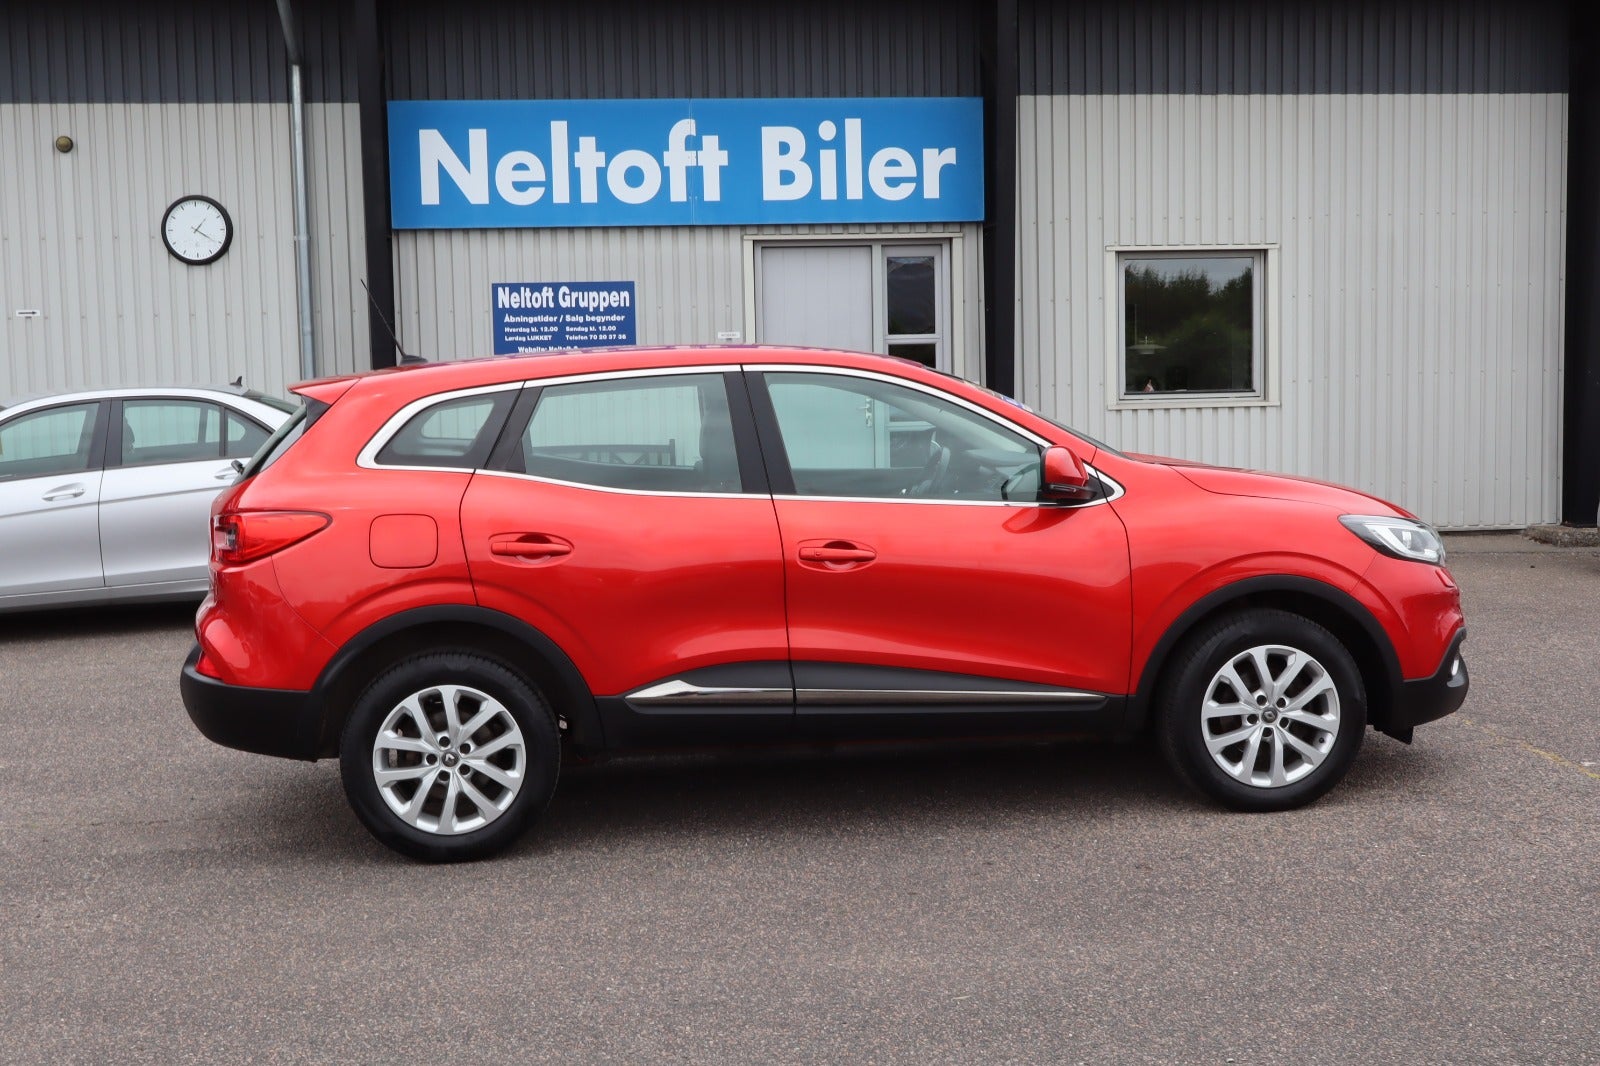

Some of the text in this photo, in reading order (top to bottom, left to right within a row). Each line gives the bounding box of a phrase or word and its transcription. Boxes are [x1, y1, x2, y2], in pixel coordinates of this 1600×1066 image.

[418, 117, 957, 207] Neltoft Biler
[497, 285, 630, 312] Neltoft Gruppen
[504, 313, 625, 324] Åbningstider / Salg begynder
[504, 326, 530, 334] Hverdag
[504, 334, 552, 343] Lørdag LUKKET
[517, 345, 547, 353] Website:
